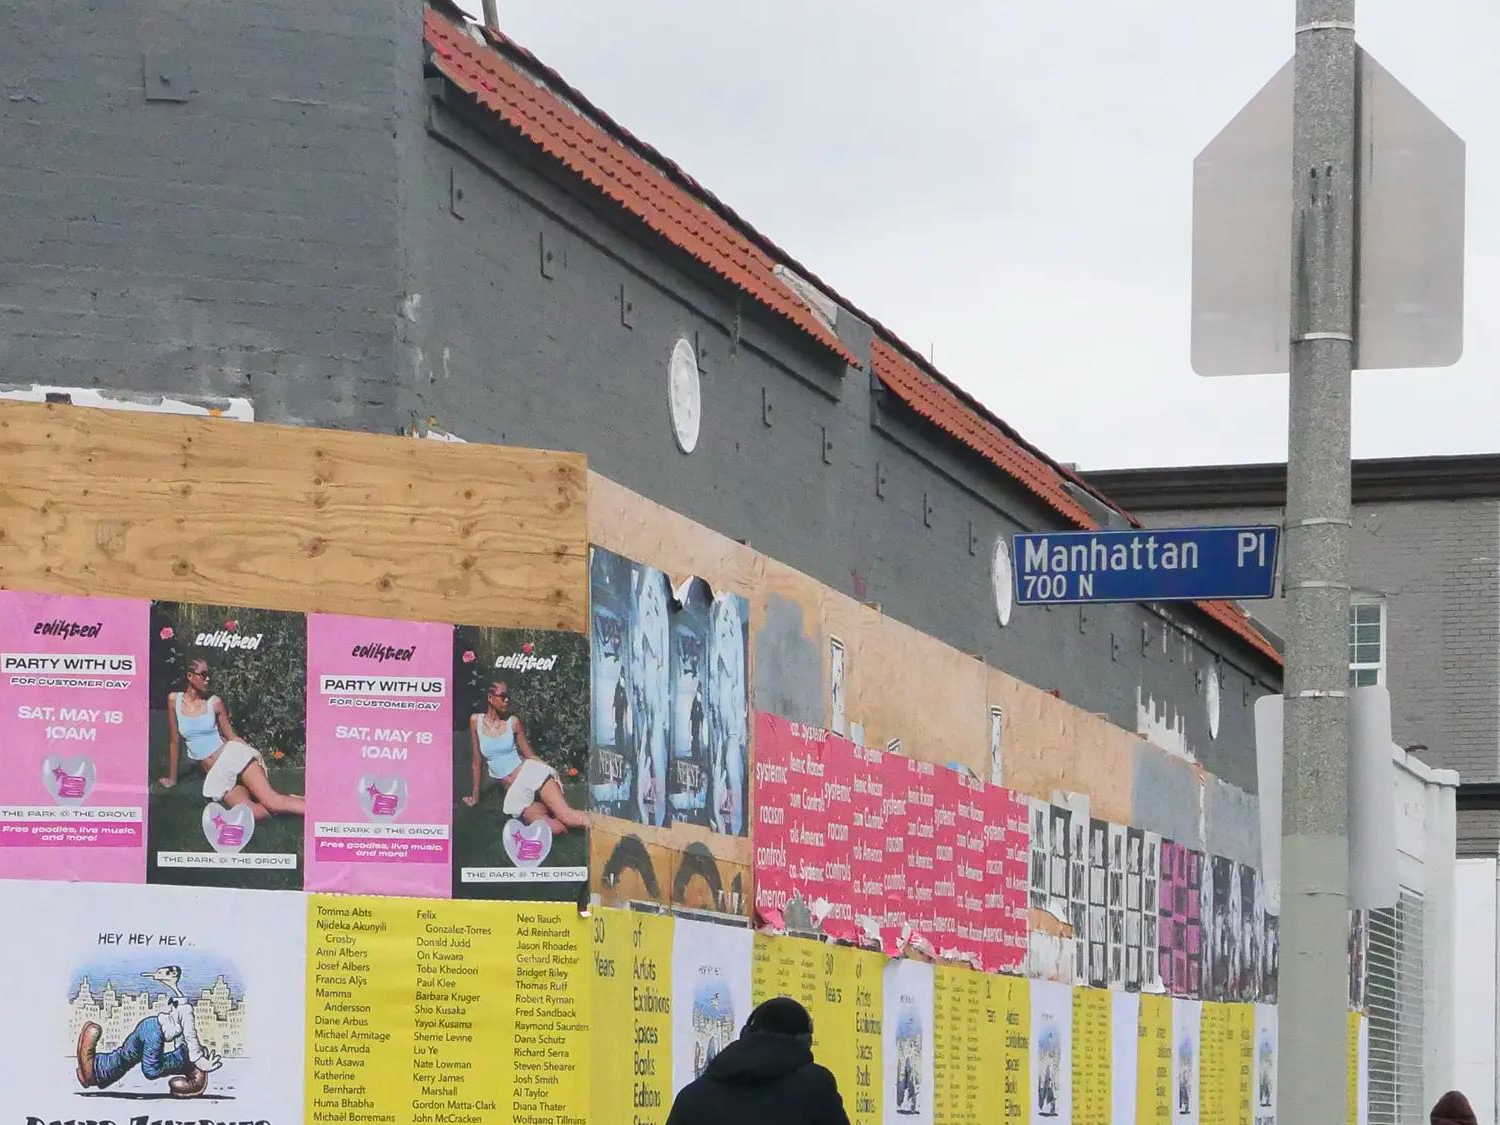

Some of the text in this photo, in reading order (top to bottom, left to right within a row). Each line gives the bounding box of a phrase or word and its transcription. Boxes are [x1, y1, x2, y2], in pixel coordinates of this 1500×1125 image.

[1024, 536, 1198, 574] Manhattan
[1024, 574, 1092, 598] 700 N
[6, 658, 132, 670] PARTY WITH US
[324, 680, 442, 692] PARTY WITH US
[336, 726, 433, 744] SAT, MAY 18
[361, 746, 408, 760] 10AM
[757, 758, 787, 788] systemic
[825, 777, 851, 808] systemic
[760, 799, 784, 825] racism
[758, 837, 786, 868] controls
[98, 932, 123, 945] HEY
[129, 933, 153, 945] HEY
[594, 918, 604, 943] 30
[634, 923, 641, 947] of
[594, 952, 615, 977] Years
[314, 1058, 364, 1067] Ruth Asawa
